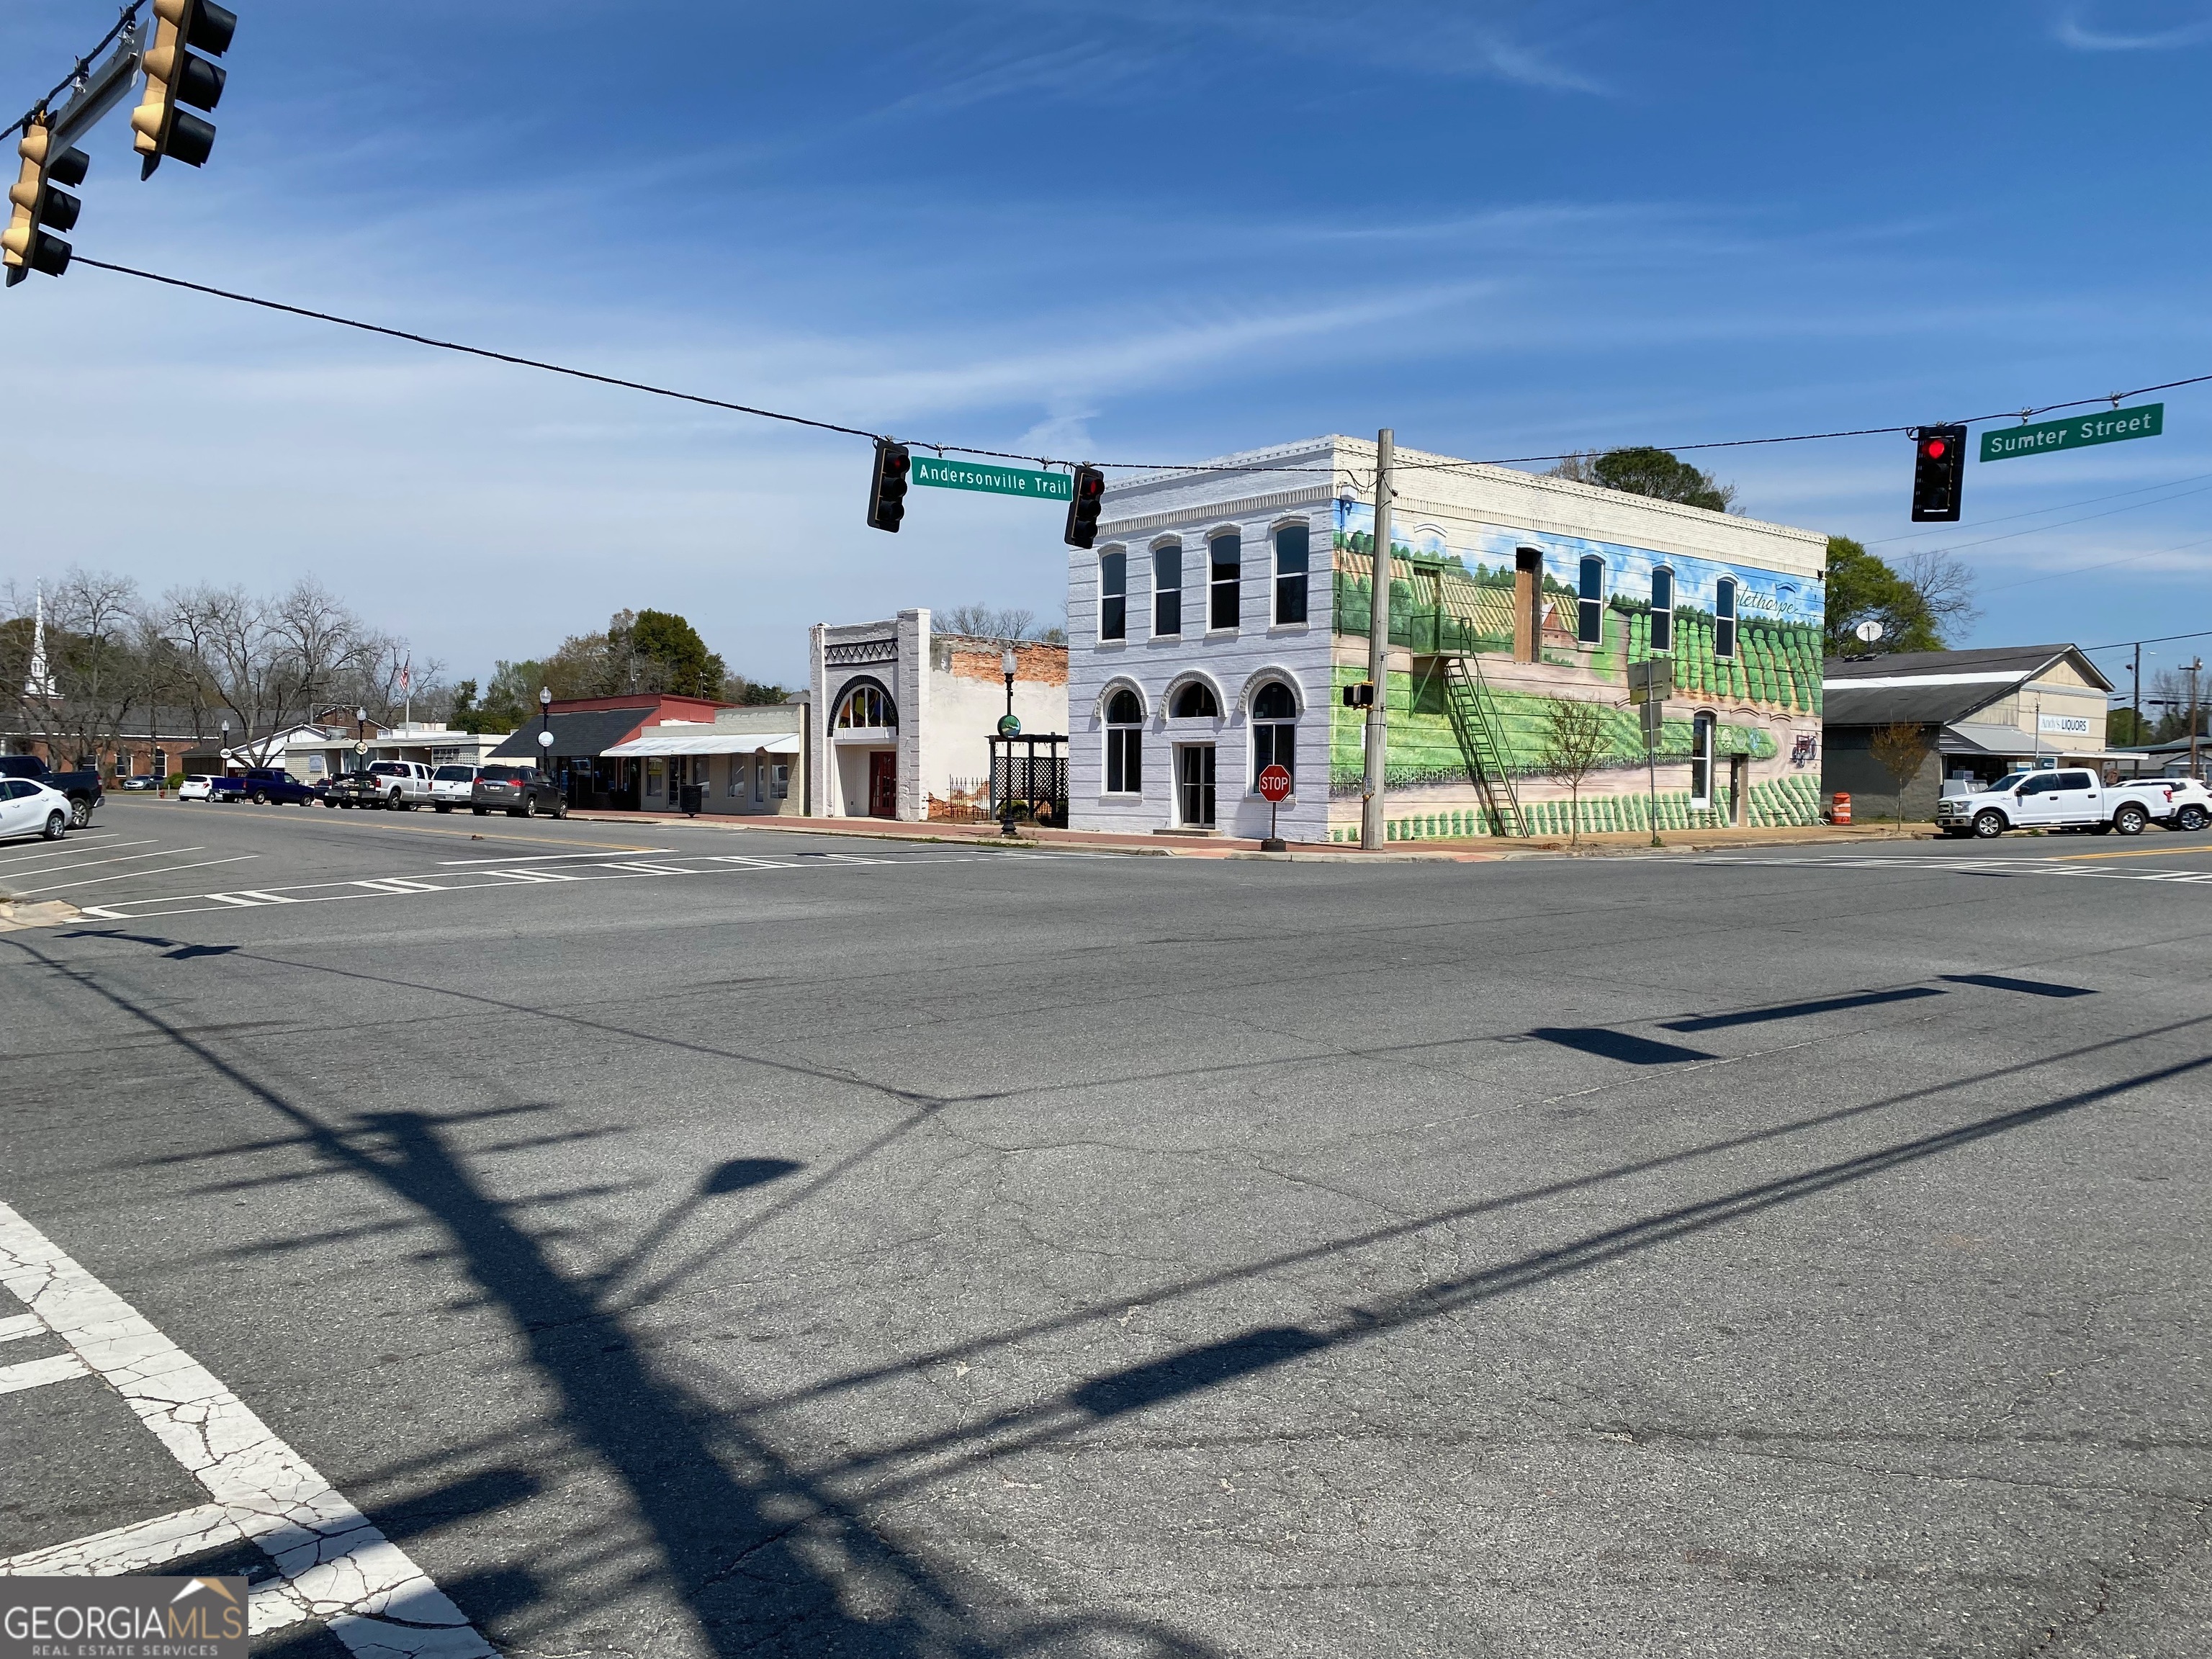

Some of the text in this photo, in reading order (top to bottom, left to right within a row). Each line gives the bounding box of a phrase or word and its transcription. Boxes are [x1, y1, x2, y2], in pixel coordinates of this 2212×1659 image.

[1991, 413, 2152, 453] Sumter Street
[920, 464, 1067, 495] Andersonville Trail
[2062, 719, 2087, 732] LIQUORS
[1262, 776, 1288, 791] STOP
